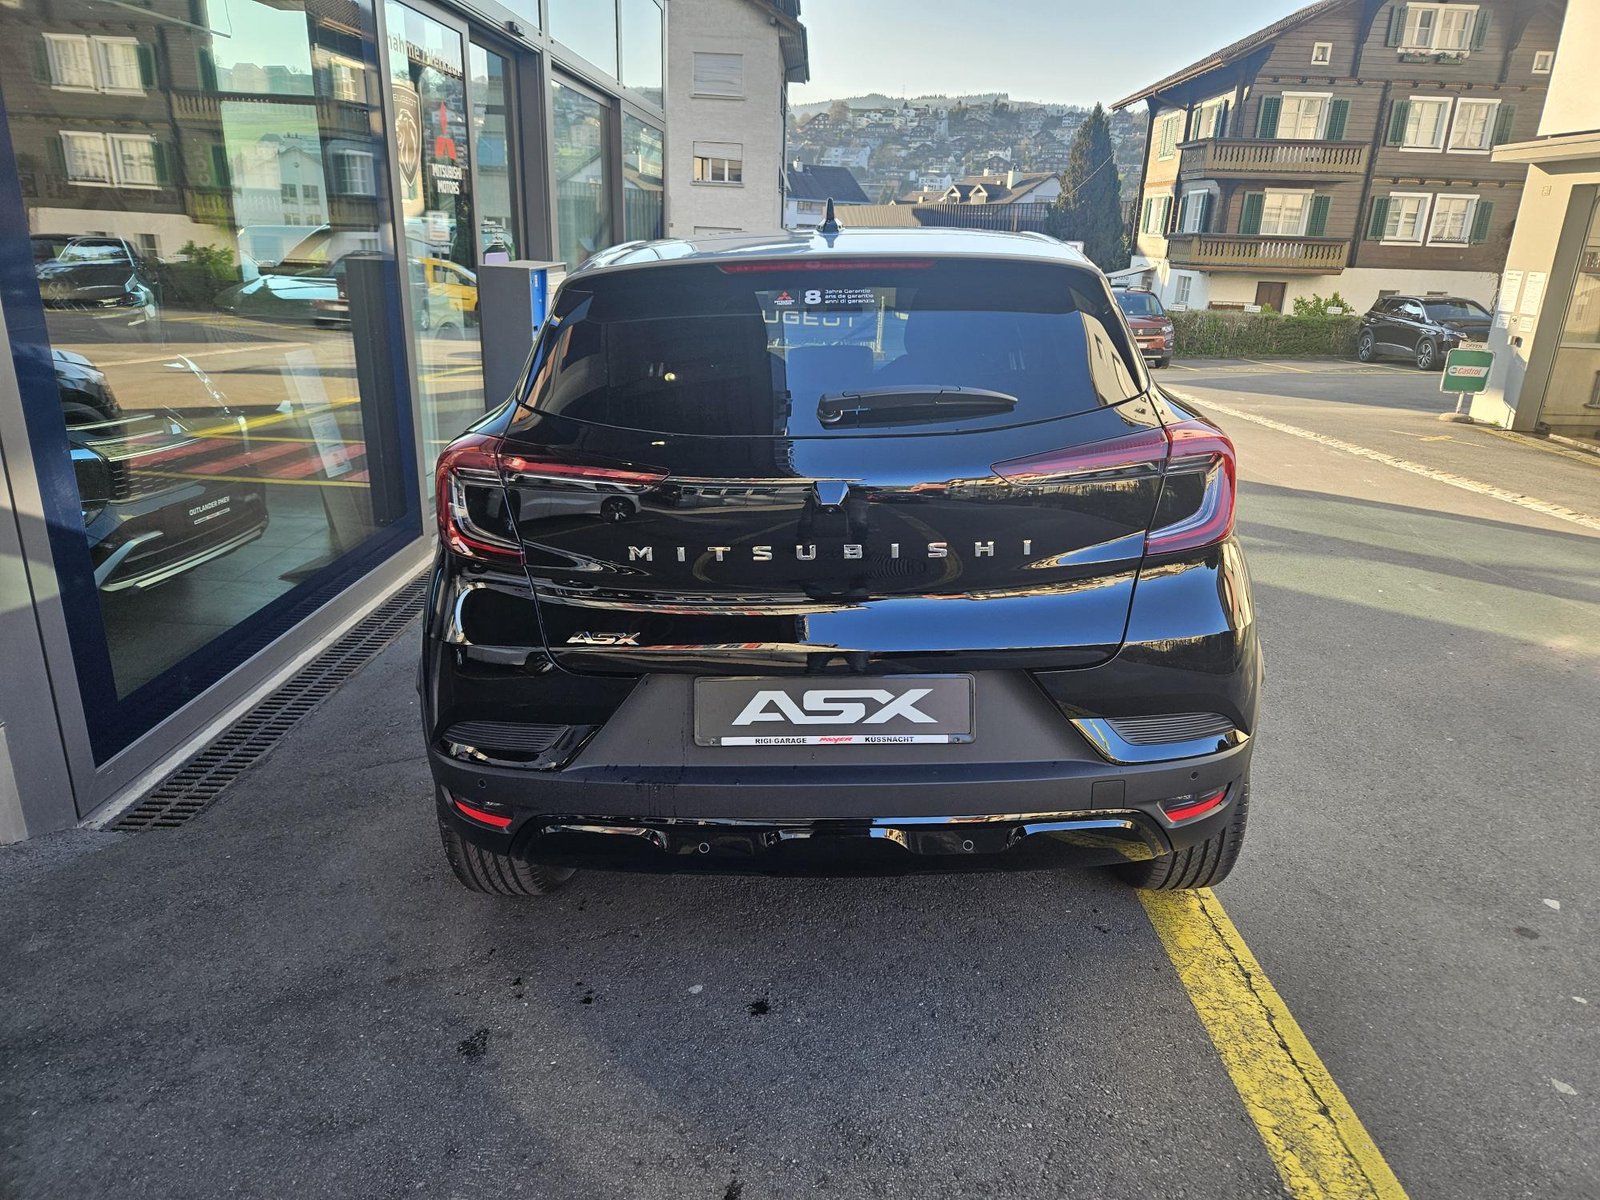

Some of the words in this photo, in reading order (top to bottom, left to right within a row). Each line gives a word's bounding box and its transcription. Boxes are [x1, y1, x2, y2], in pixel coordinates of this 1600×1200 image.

[432, 163, 463, 180] MITSUBISHI
[437, 180, 460, 195] MOTORS
[805, 290, 821, 305] 8
[1457, 367, 1482, 376] Castrol
[189, 500, 217, 516] OUTLANDER
[628, 539, 1032, 562] MITSUBISHI
[566, 631, 640, 646] ASX
[731, 688, 939, 726] ASX
